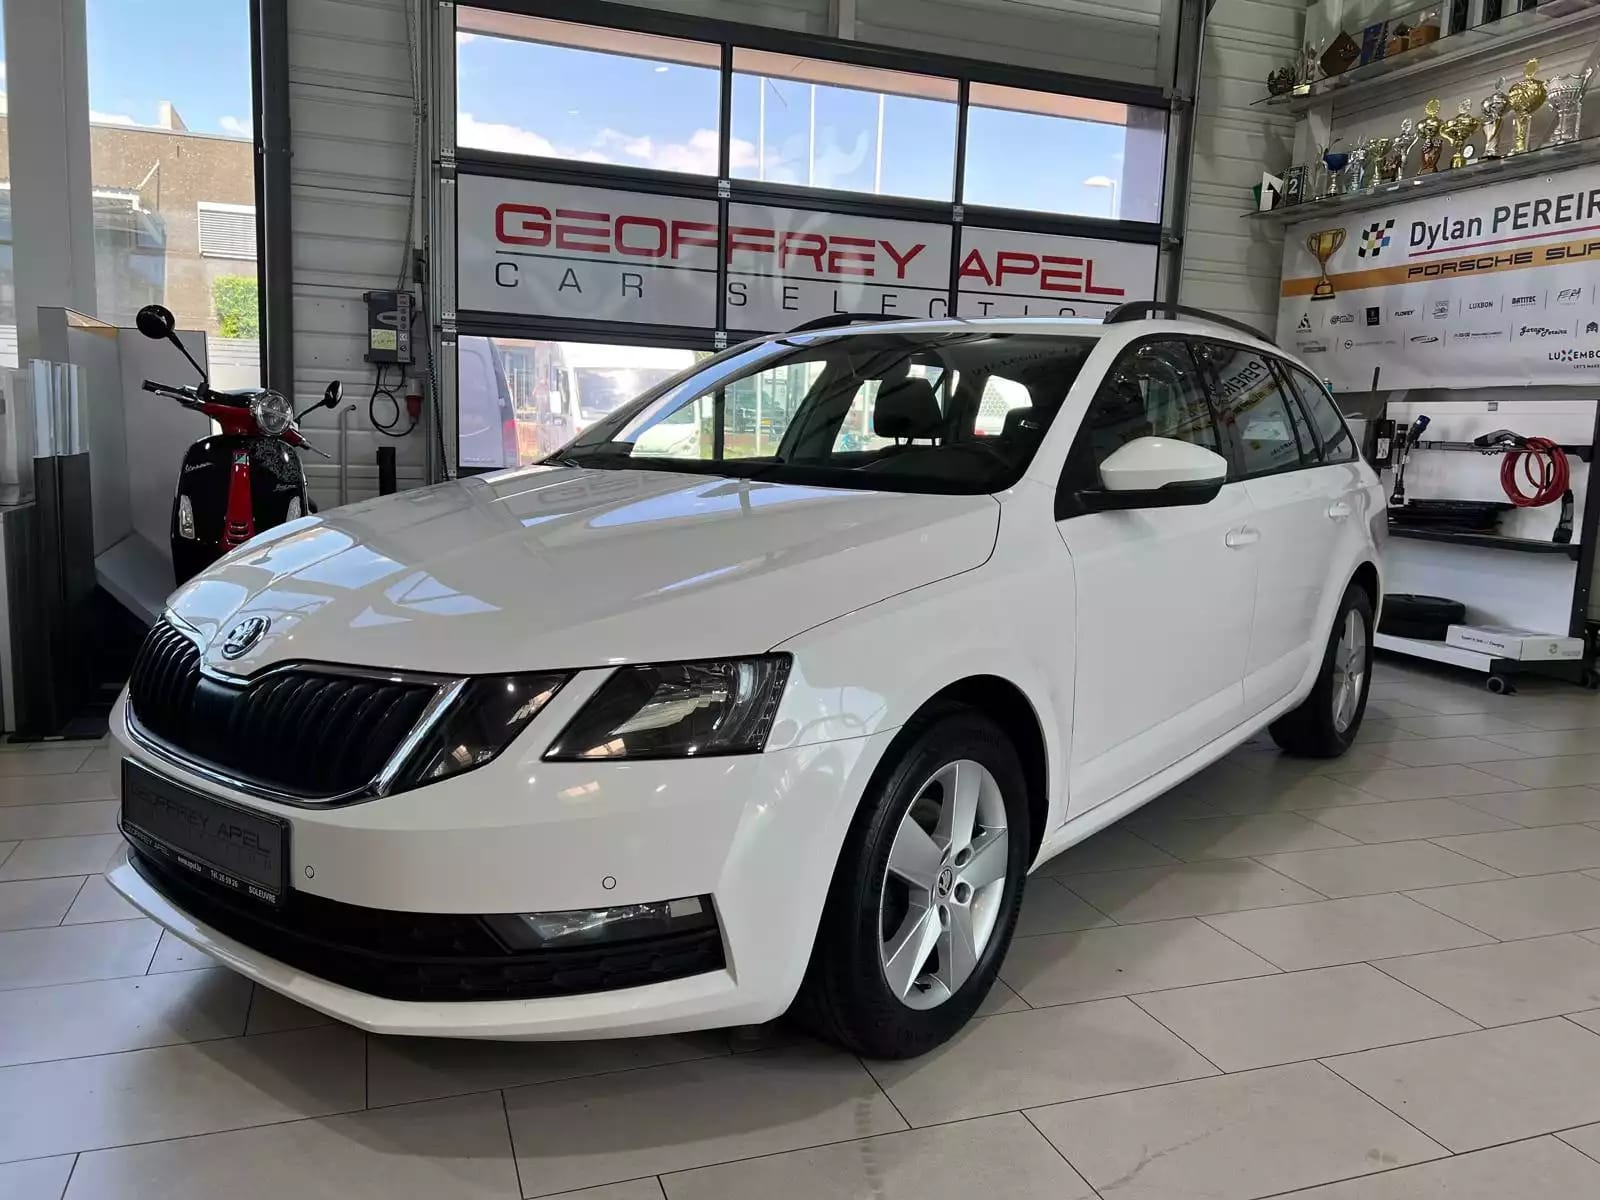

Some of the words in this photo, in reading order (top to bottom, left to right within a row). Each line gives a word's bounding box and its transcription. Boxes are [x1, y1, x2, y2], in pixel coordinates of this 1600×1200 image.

[1409, 216, 1483, 250] Dylan
[1492, 188, 1600, 233] PEREIR
[495, 203, 927, 280] GEOFFREY
[957, 248, 1125, 296] APEL
[1407, 251, 1533, 279] PORSCHE
[495, 262, 643, 298] CAR
[728, 282, 1110, 318] SELECTI
[1468, 301, 1494, 310] LUXBON
